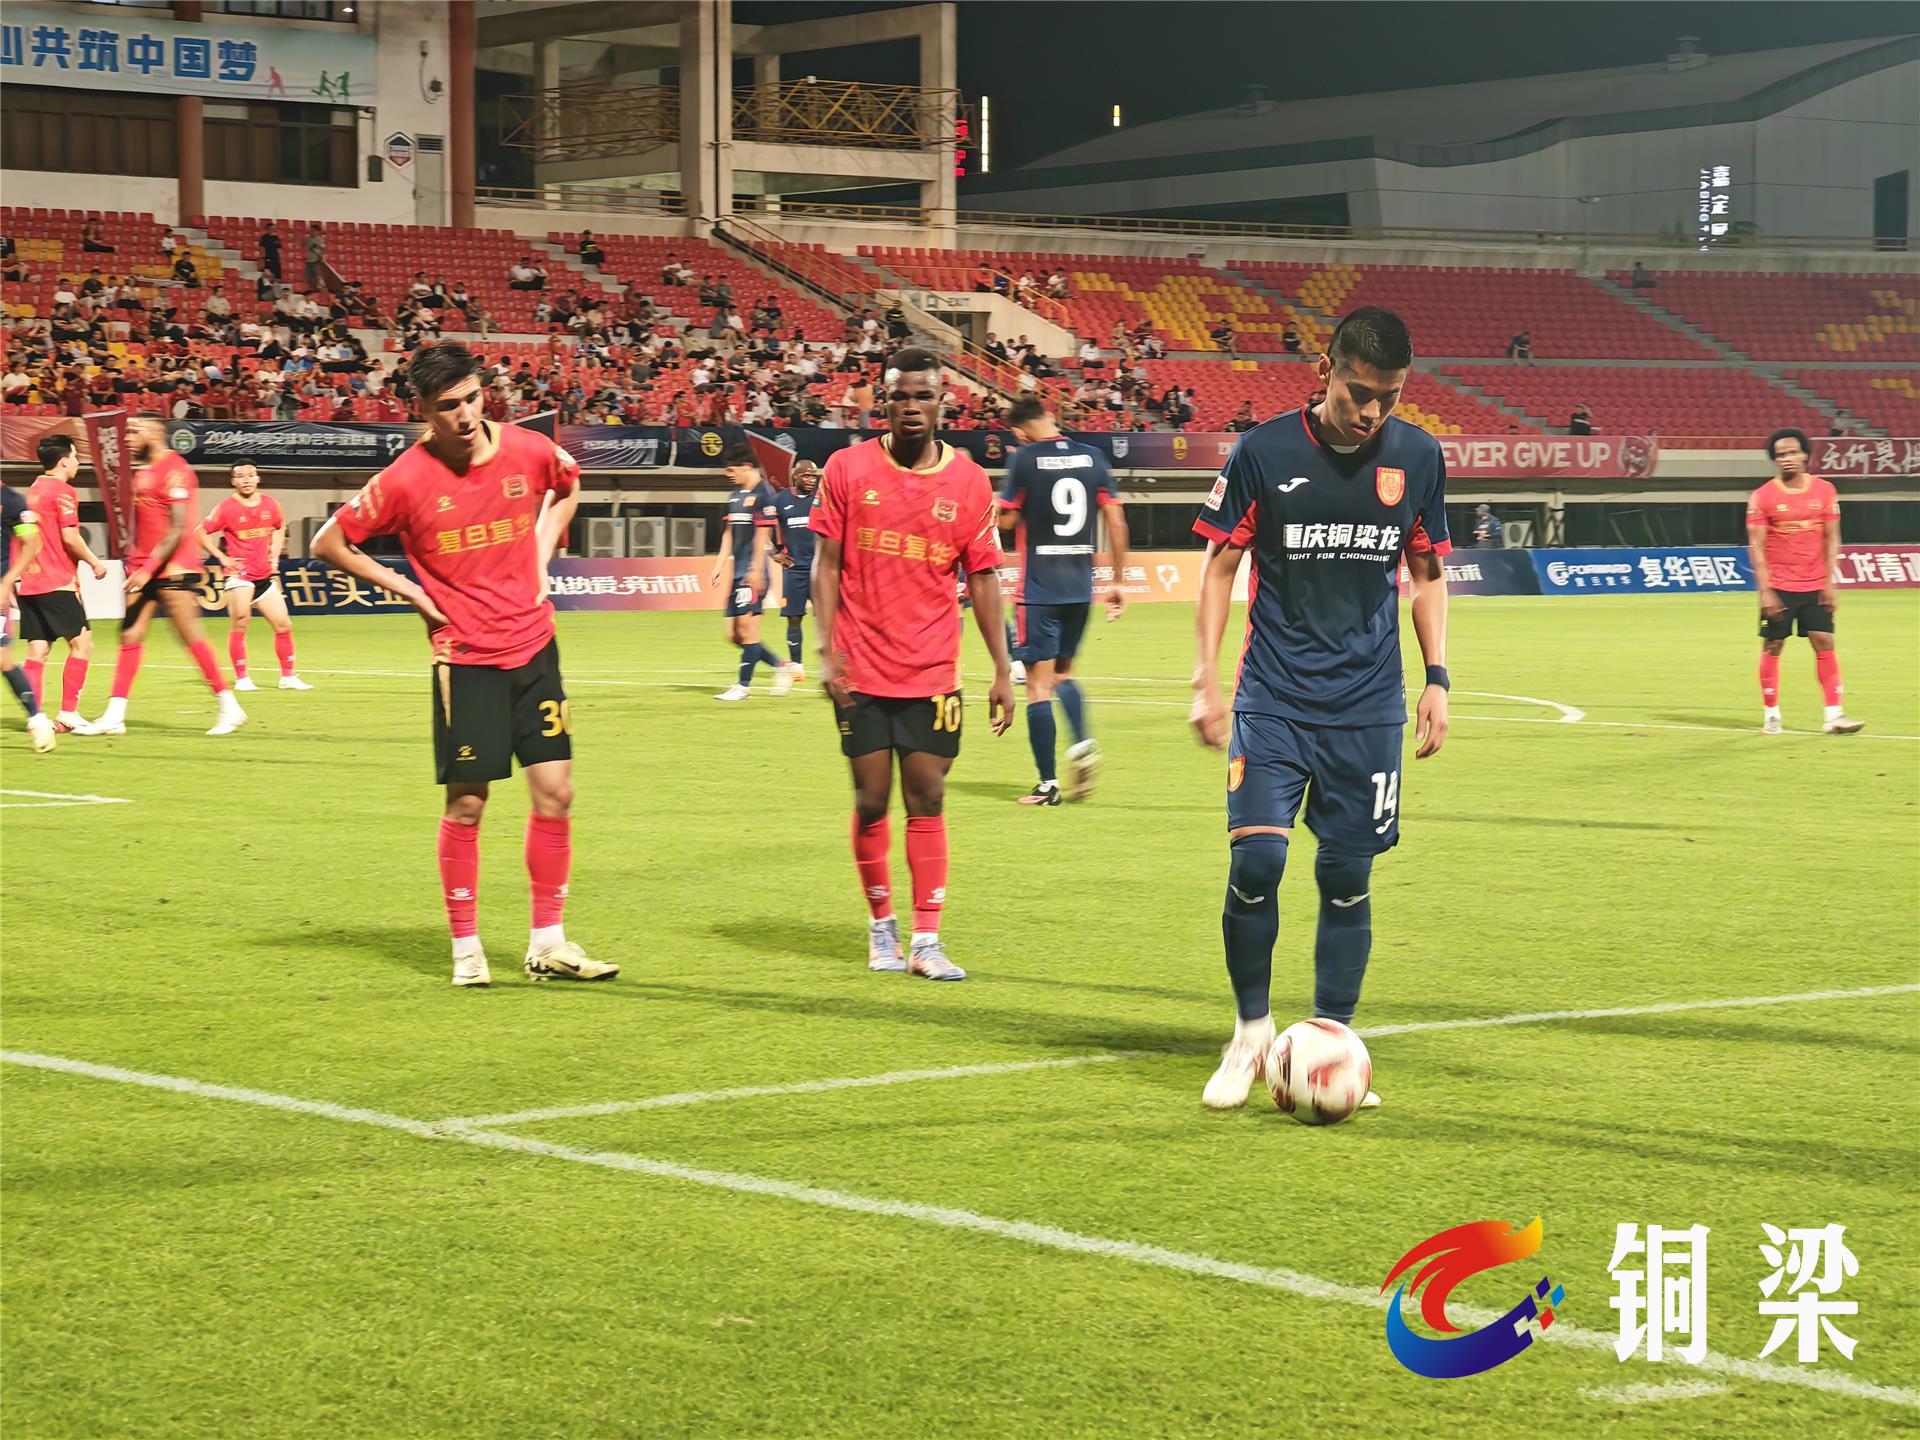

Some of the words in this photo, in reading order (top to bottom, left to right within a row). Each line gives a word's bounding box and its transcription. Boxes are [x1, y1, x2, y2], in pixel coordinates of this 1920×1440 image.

[1513, 441, 1571, 468] GIVE
[1577, 441, 1611, 468] UP
[1051, 478, 1088, 537] 9
[1287, 552, 1311, 561] IGHT
[1317, 552, 1335, 560] FOR
[1638, 556, 1746, 587] 复华园区
[931, 694, 961, 732] 10
[1371, 770, 1399, 820] 14
